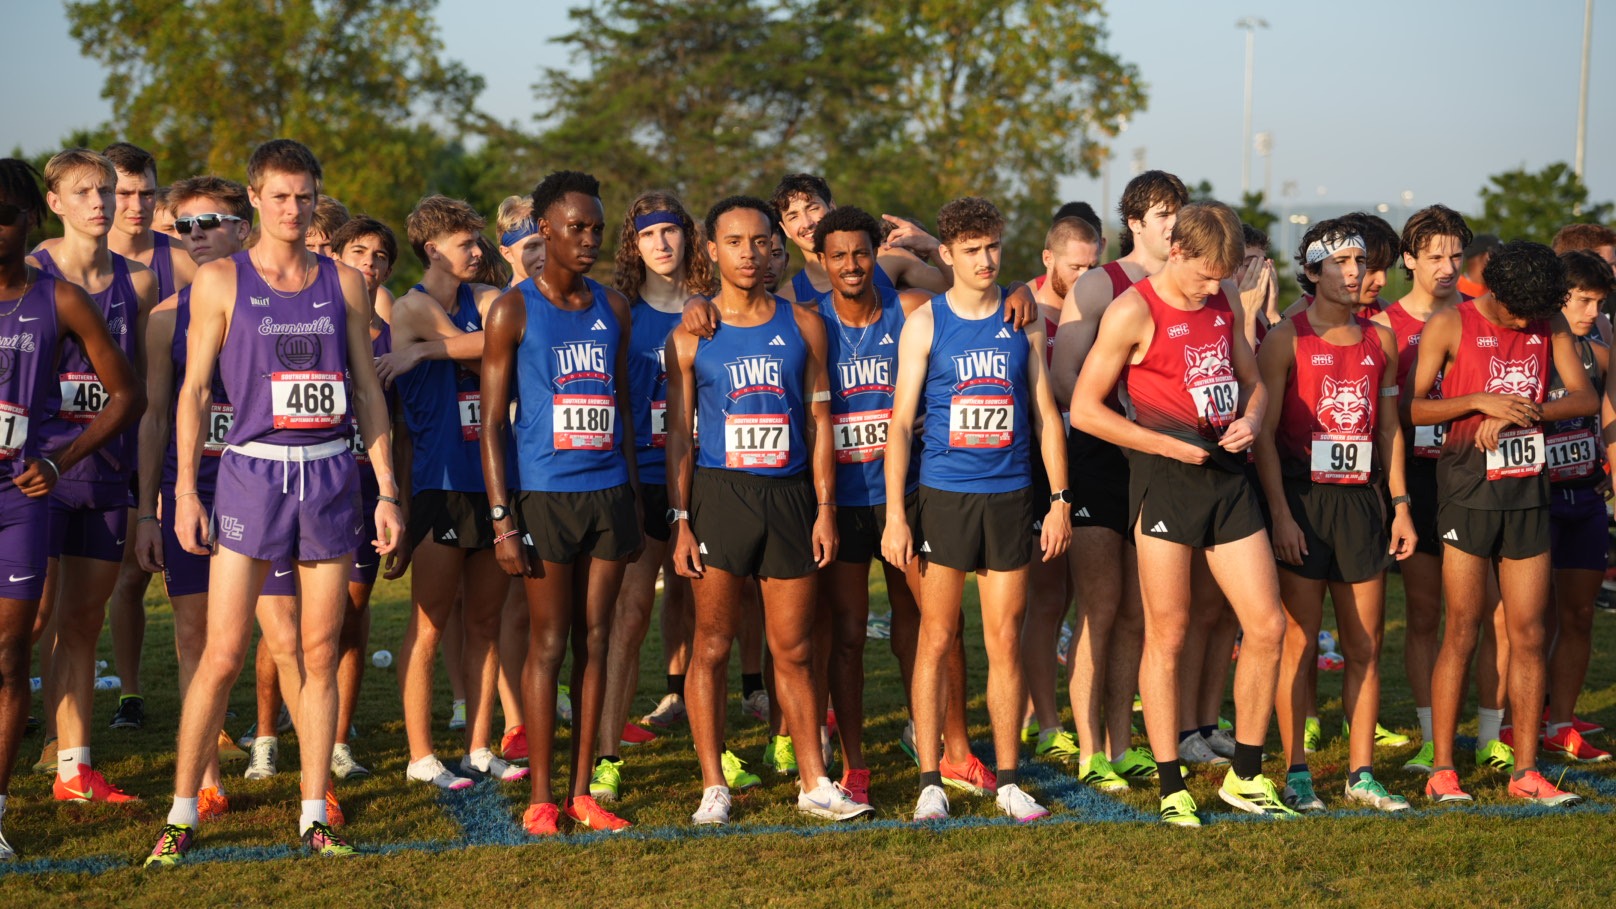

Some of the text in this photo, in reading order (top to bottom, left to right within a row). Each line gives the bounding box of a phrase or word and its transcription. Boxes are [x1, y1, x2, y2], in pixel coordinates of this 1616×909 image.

[250, 296, 270, 305] VALLEY
[258, 316, 335, 336] Evansville
[1167, 322, 1190, 339] SBC
[1476, 336, 1499, 347] SBC
[557, 343, 605, 375] UWG
[957, 351, 1006, 382] UWG
[1311, 354, 1334, 366] SBC
[281, 373, 337, 381] SOUTHERN SHOWCASE
[730, 357, 780, 390] UWG
[842, 358, 889, 390] UWG
[1193, 378, 1215, 387] SOUTHERN
[286, 383, 335, 414] 468
[563, 408, 610, 432] 1180
[840, 413, 889, 424] SOUTHERN SHOWCASE
[960, 407, 1008, 431] 1172
[735, 427, 783, 450] 1177
[841, 421, 889, 448] 1183
[1516, 427, 1538, 436] SHOWCASE
[1547, 432, 1588, 445] SOUTHERN SHOWCASE
[1331, 443, 1358, 471] 99
[1499, 436, 1536, 468] 105
[1550, 440, 1591, 467] 1193
[221, 515, 245, 541] UE
